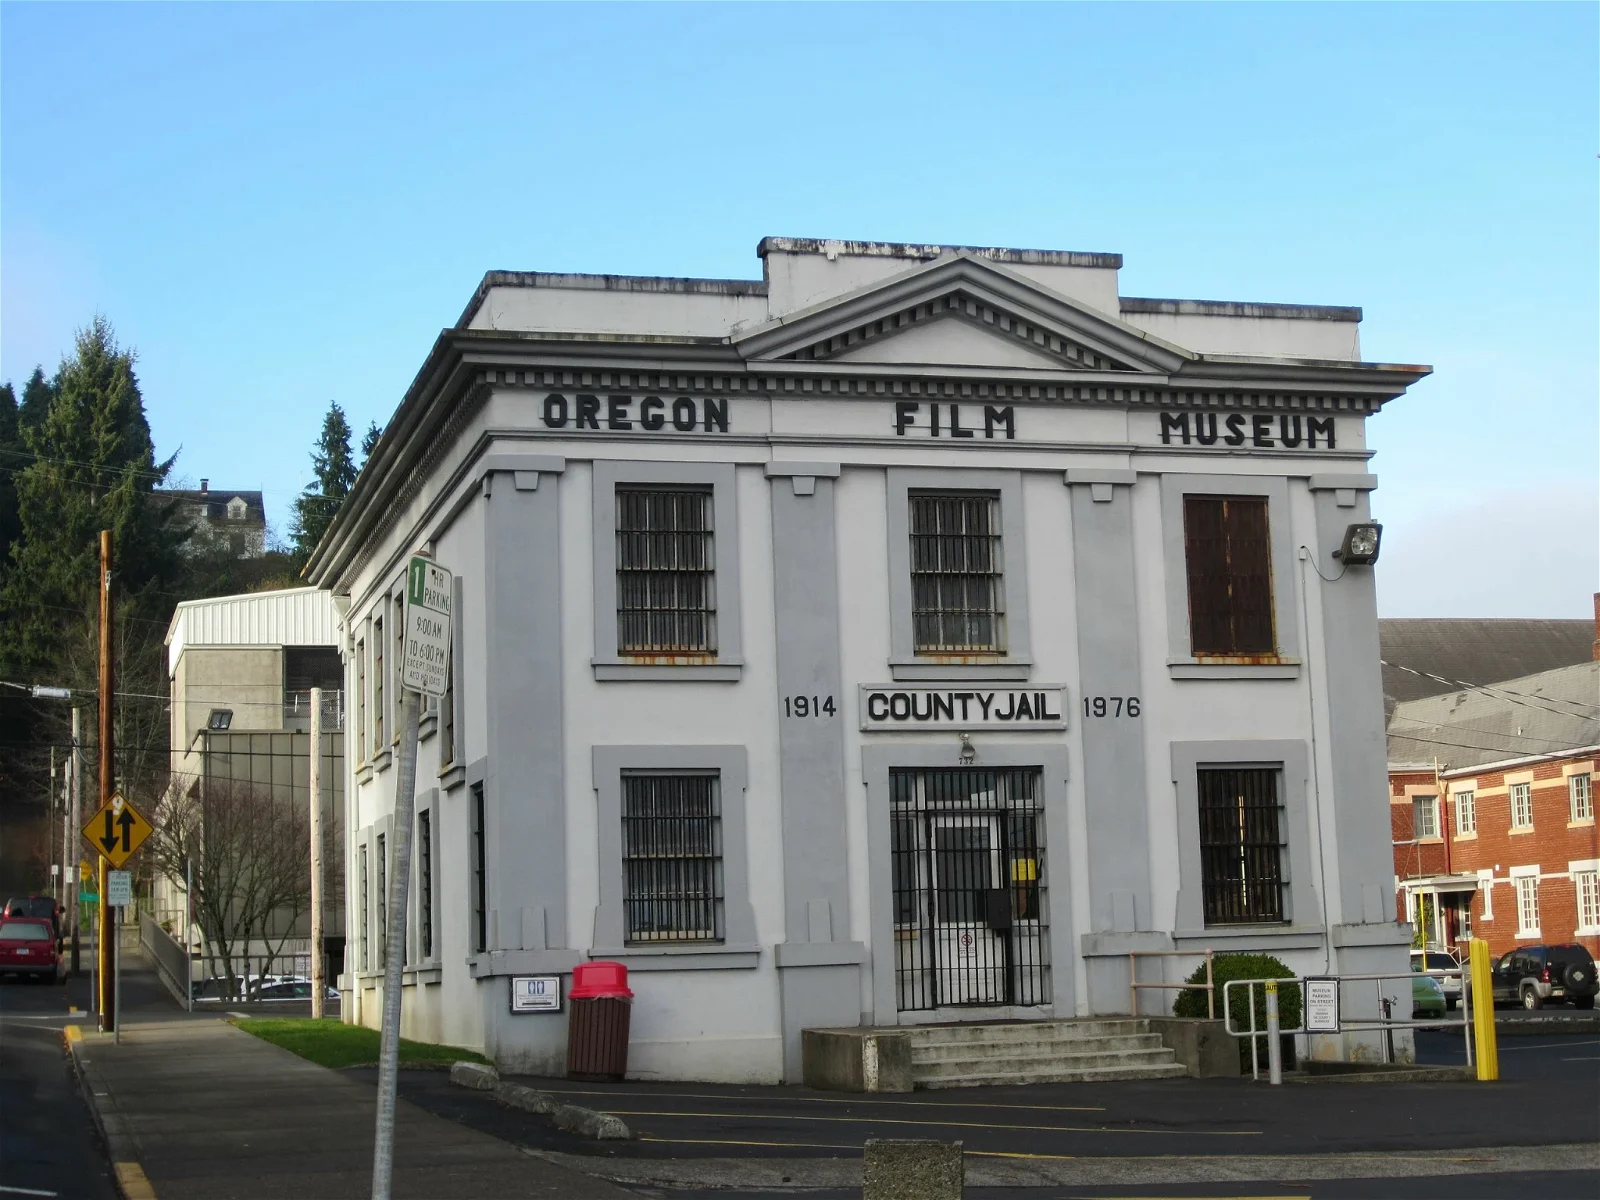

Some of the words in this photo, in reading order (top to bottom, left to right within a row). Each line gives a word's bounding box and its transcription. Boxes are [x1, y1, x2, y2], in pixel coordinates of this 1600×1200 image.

[543, 393, 729, 432] OREGON
[896, 402, 1014, 439] FILM
[1160, 412, 1336, 449] MUSEUM
[414, 566, 420, 598] 1
[433, 572, 444, 588] HR
[424, 587, 450, 611] PARKING
[416, 616, 431, 636] 9:00
[432, 622, 442, 640] AM
[409, 639, 418, 657] TO
[420, 643, 434, 661] 6:00
[435, 648, 444, 665] PM
[407, 657, 425, 670] EXCEPT
[426, 662, 444, 677] SUNDAYS
[409, 670, 420, 680] AND
[784, 695, 837, 718] 1914
[868, 692, 995, 721] COUNTY
[995, 692, 1061, 721] JAIL
[1084, 696, 1141, 718] 1976
[958, 756, 974, 765] 732
